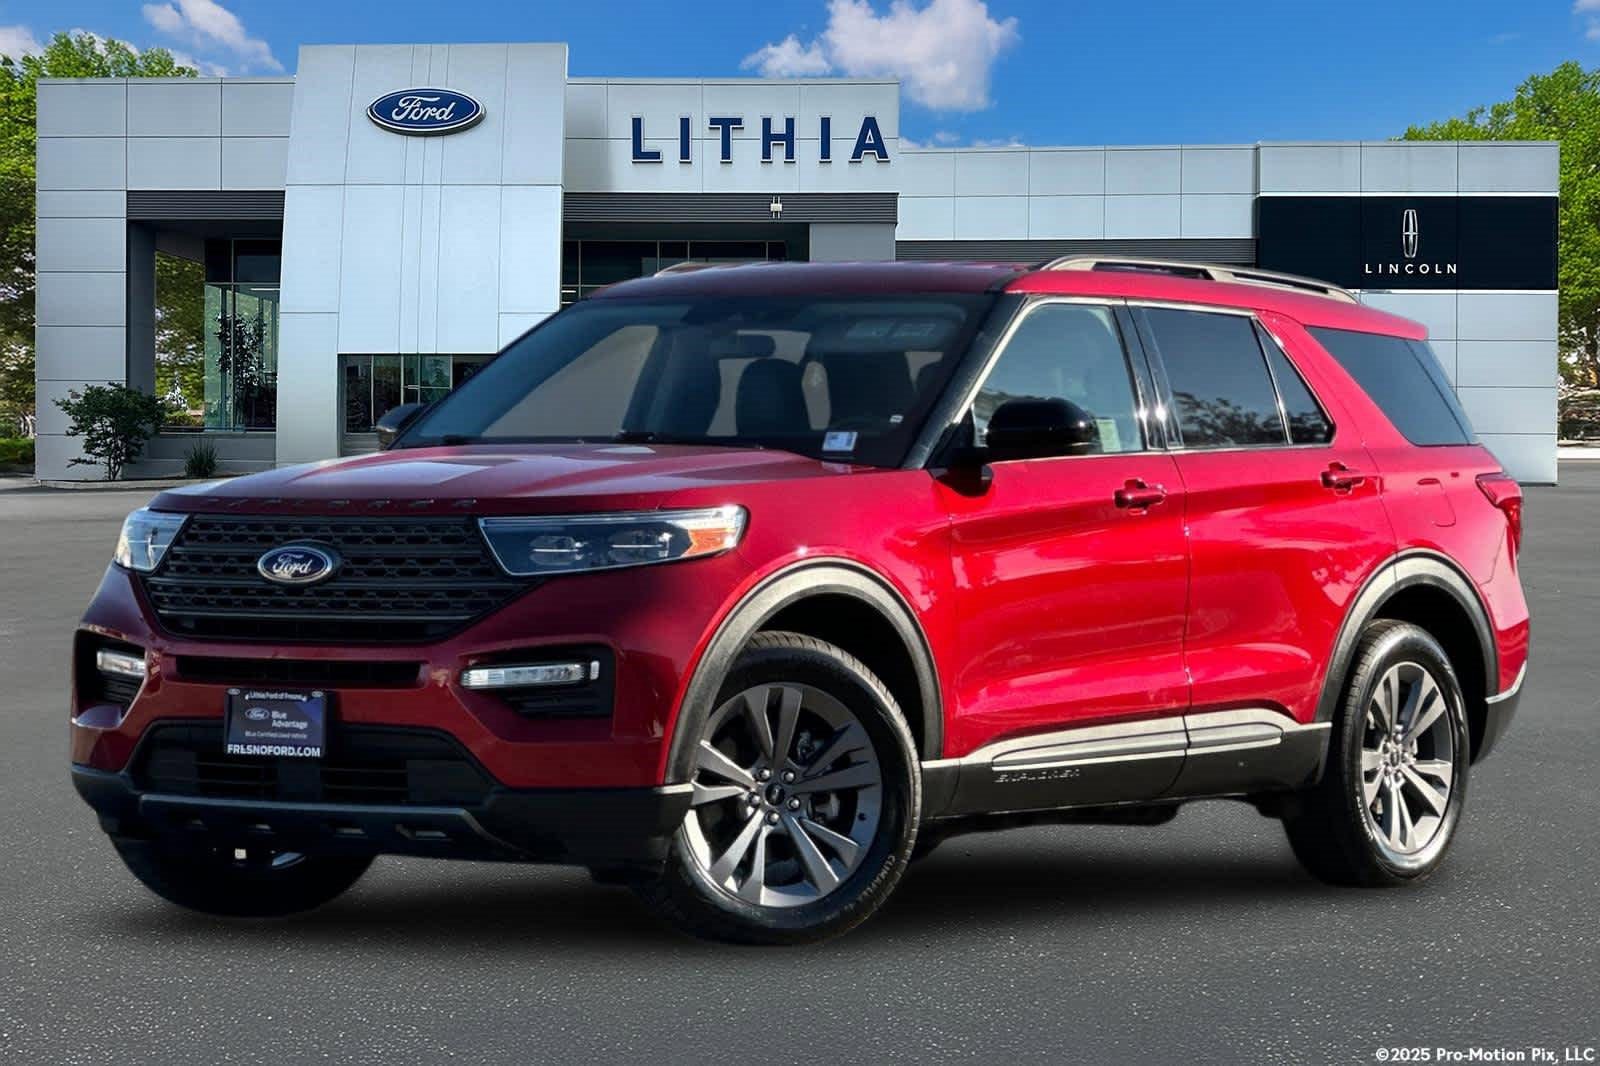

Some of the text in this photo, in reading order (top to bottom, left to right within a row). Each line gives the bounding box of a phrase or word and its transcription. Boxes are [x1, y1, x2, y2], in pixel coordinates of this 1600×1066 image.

[391, 95, 456, 121] Ford
[631, 116, 891, 163] LITHIA
[1365, 263, 1457, 274] LINCOLN
[272, 710, 287, 720] Blue
[272, 719, 309, 730] Advantage
